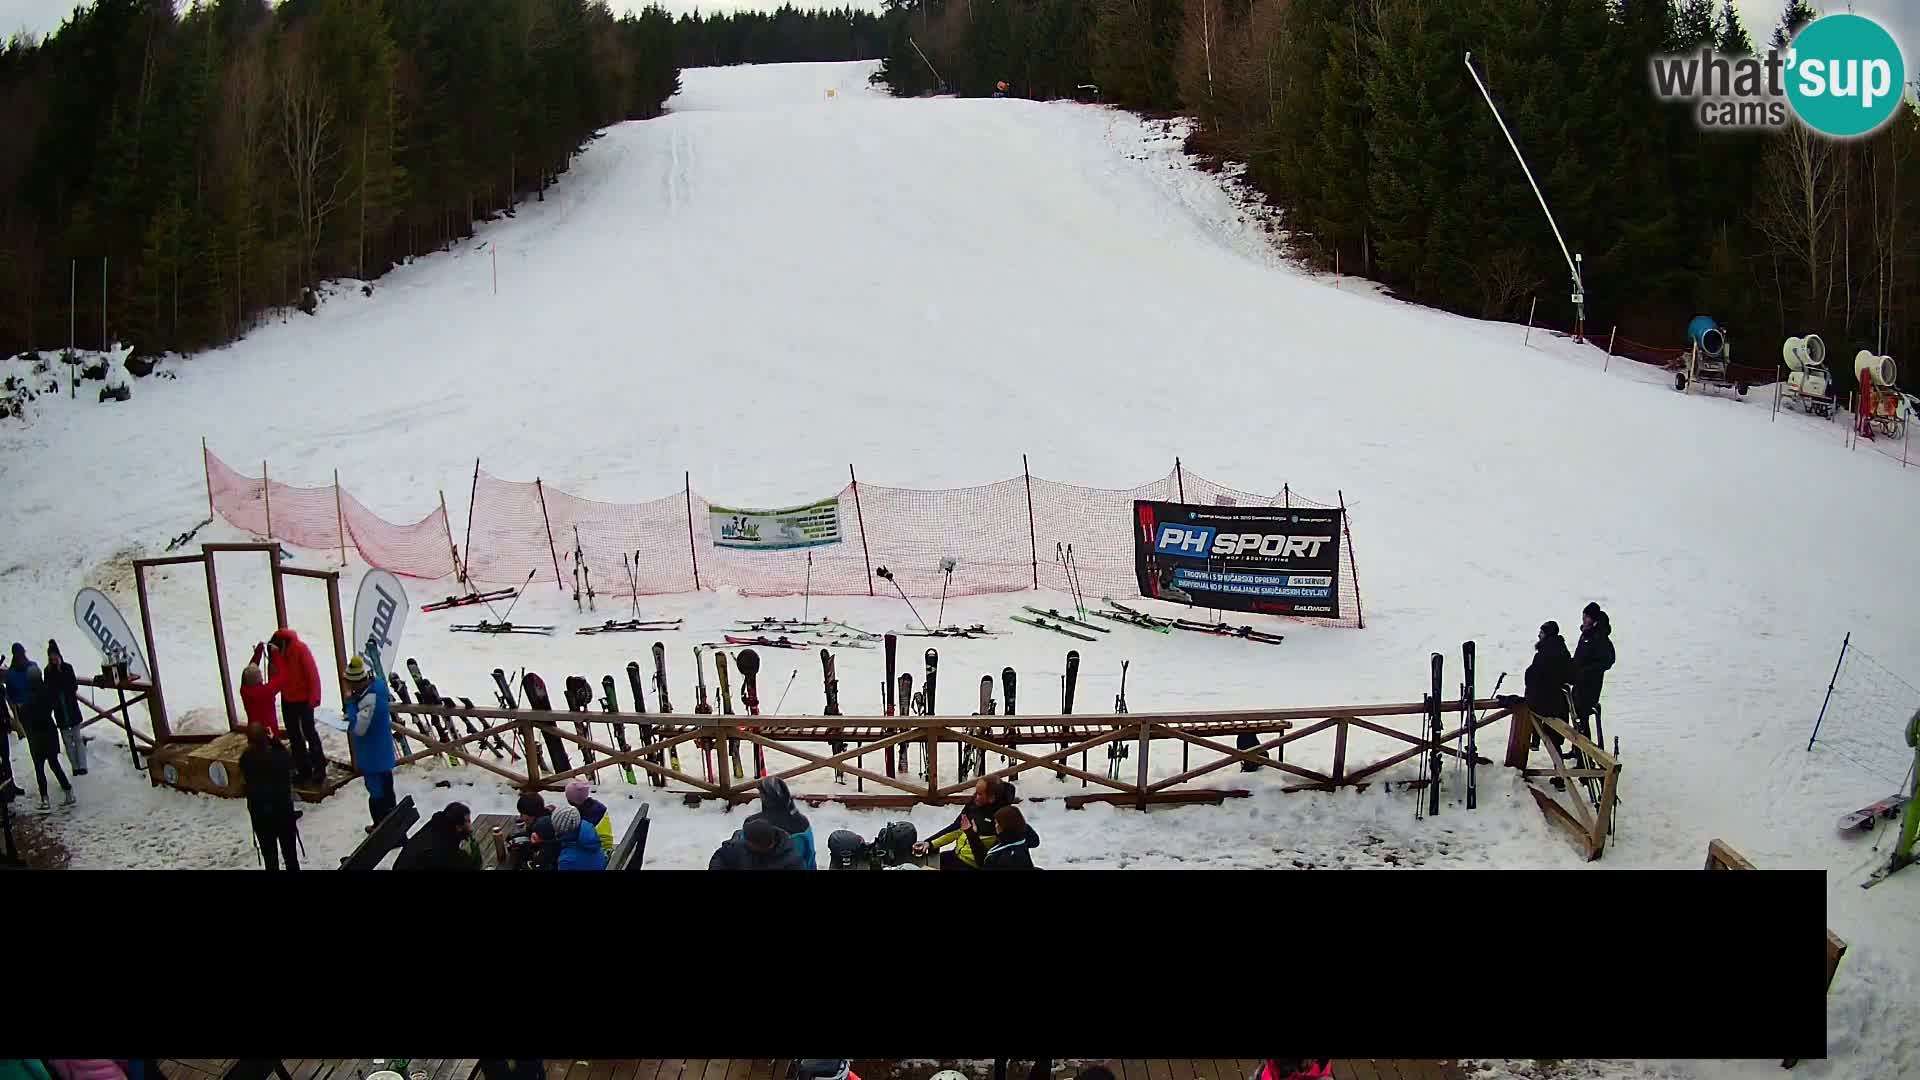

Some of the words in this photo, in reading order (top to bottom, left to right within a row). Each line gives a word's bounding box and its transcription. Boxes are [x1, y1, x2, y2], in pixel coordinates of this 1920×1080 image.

[1159, 528, 1208, 553] PH
[1212, 533, 1332, 558] SPORT
[1255, 576, 1280, 585] OPREMO
[1293, 577, 1303, 585] SKI
[1304, 577, 1326, 585] SERVIS
[1293, 604, 1331, 612] SALOMON
